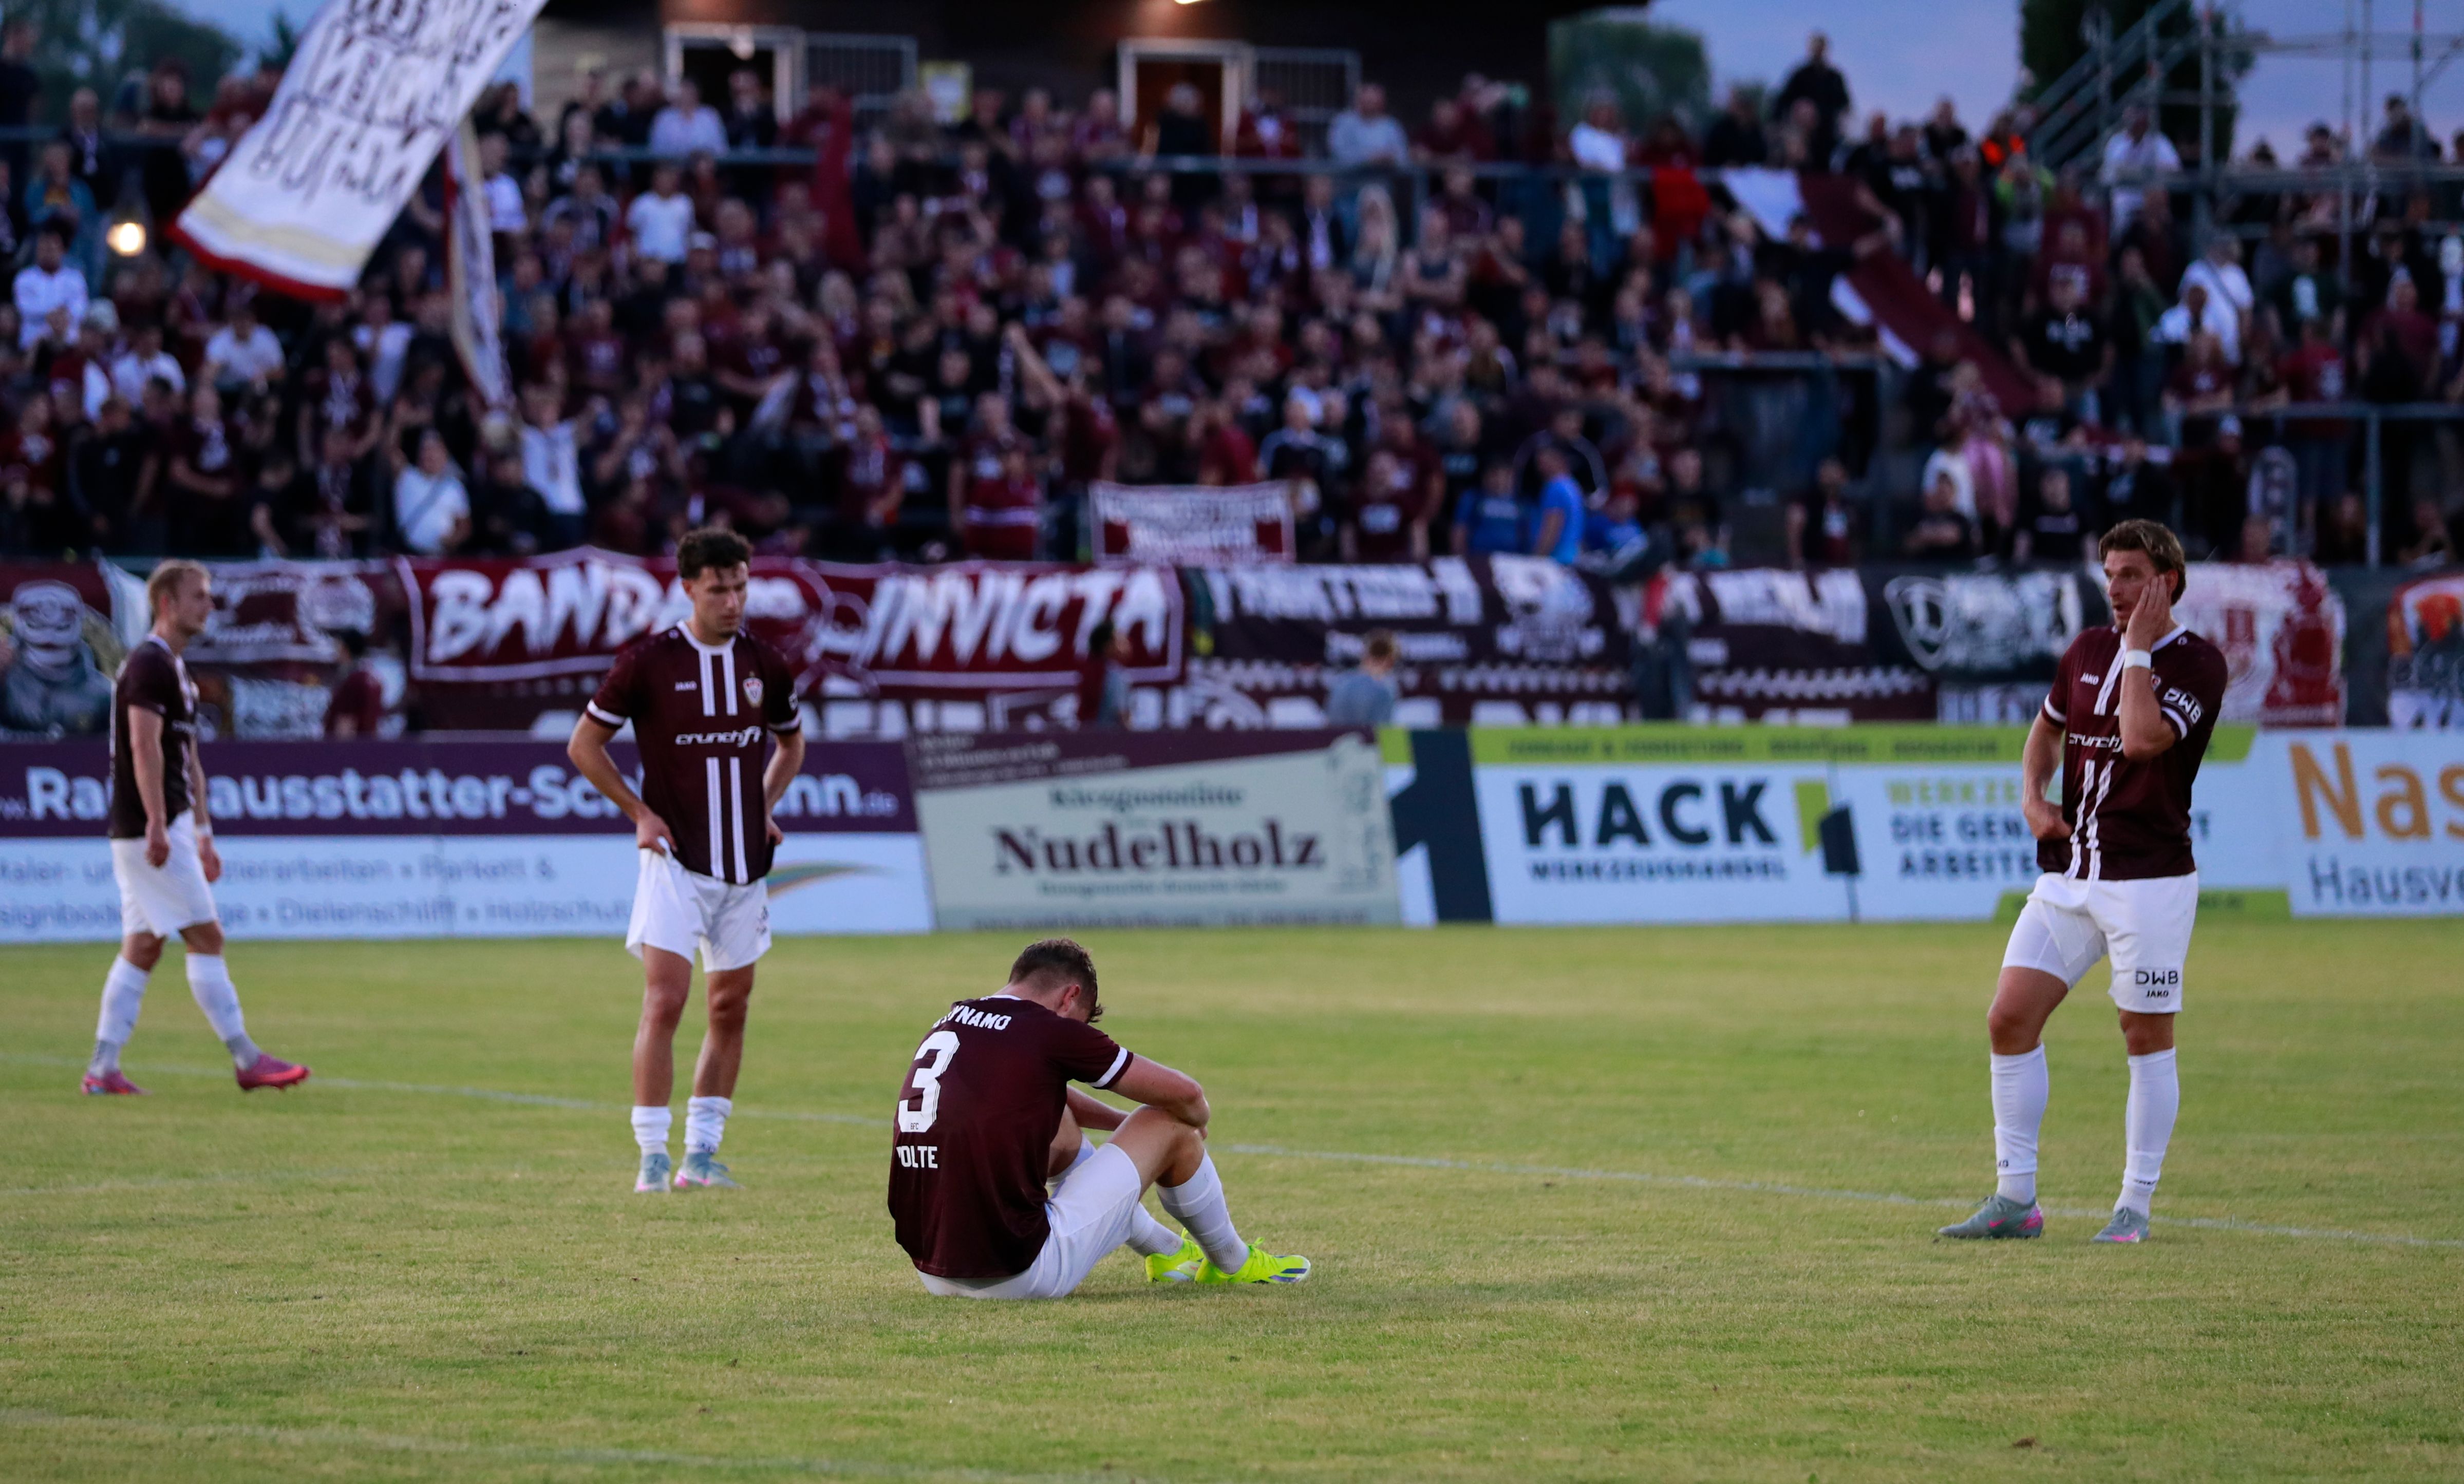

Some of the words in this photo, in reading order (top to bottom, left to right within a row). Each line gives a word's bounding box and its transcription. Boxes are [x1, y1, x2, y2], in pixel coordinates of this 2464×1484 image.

[856, 566, 1170, 667] INVICTA
[2080, 673, 2099, 686] JAKO
[2163, 687, 2202, 725] DWB
[1518, 777, 1778, 848] HACK
[994, 816, 1324, 875] Nudelholz
[2135, 971, 2178, 985] DWB
[2146, 990, 2169, 998] JAKO
[897, 1030, 960, 1133] 3
